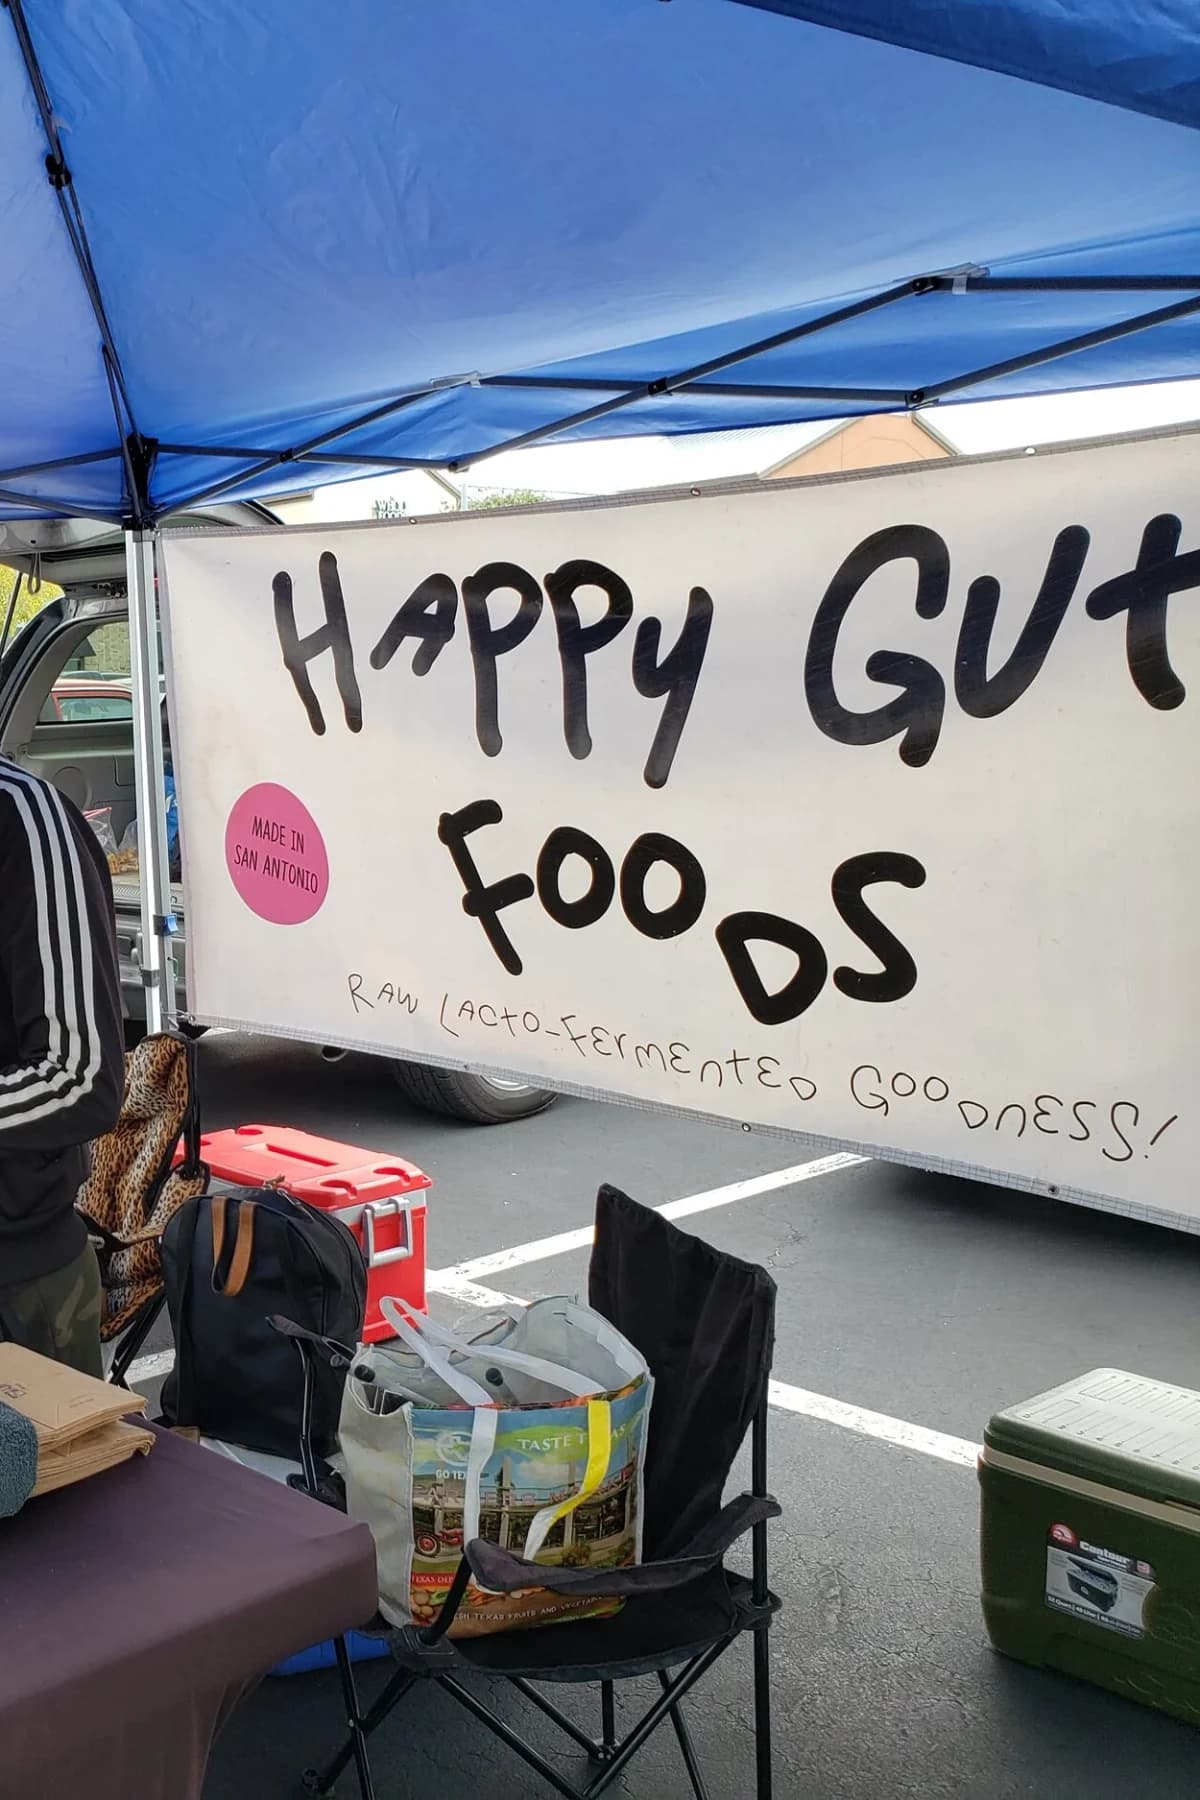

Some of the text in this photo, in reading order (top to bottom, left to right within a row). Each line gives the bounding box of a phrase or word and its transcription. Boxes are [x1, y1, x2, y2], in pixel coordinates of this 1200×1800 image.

[252, 815, 305, 855] MADE IN
[233, 844, 319, 894] SAN ANTONIO
[438, 799, 927, 1025] FOODS
[347, 973, 419, 1015] RAW
[519, 1435, 576, 1451] TASTE
[1079, 1540, 1132, 1564] Contour
